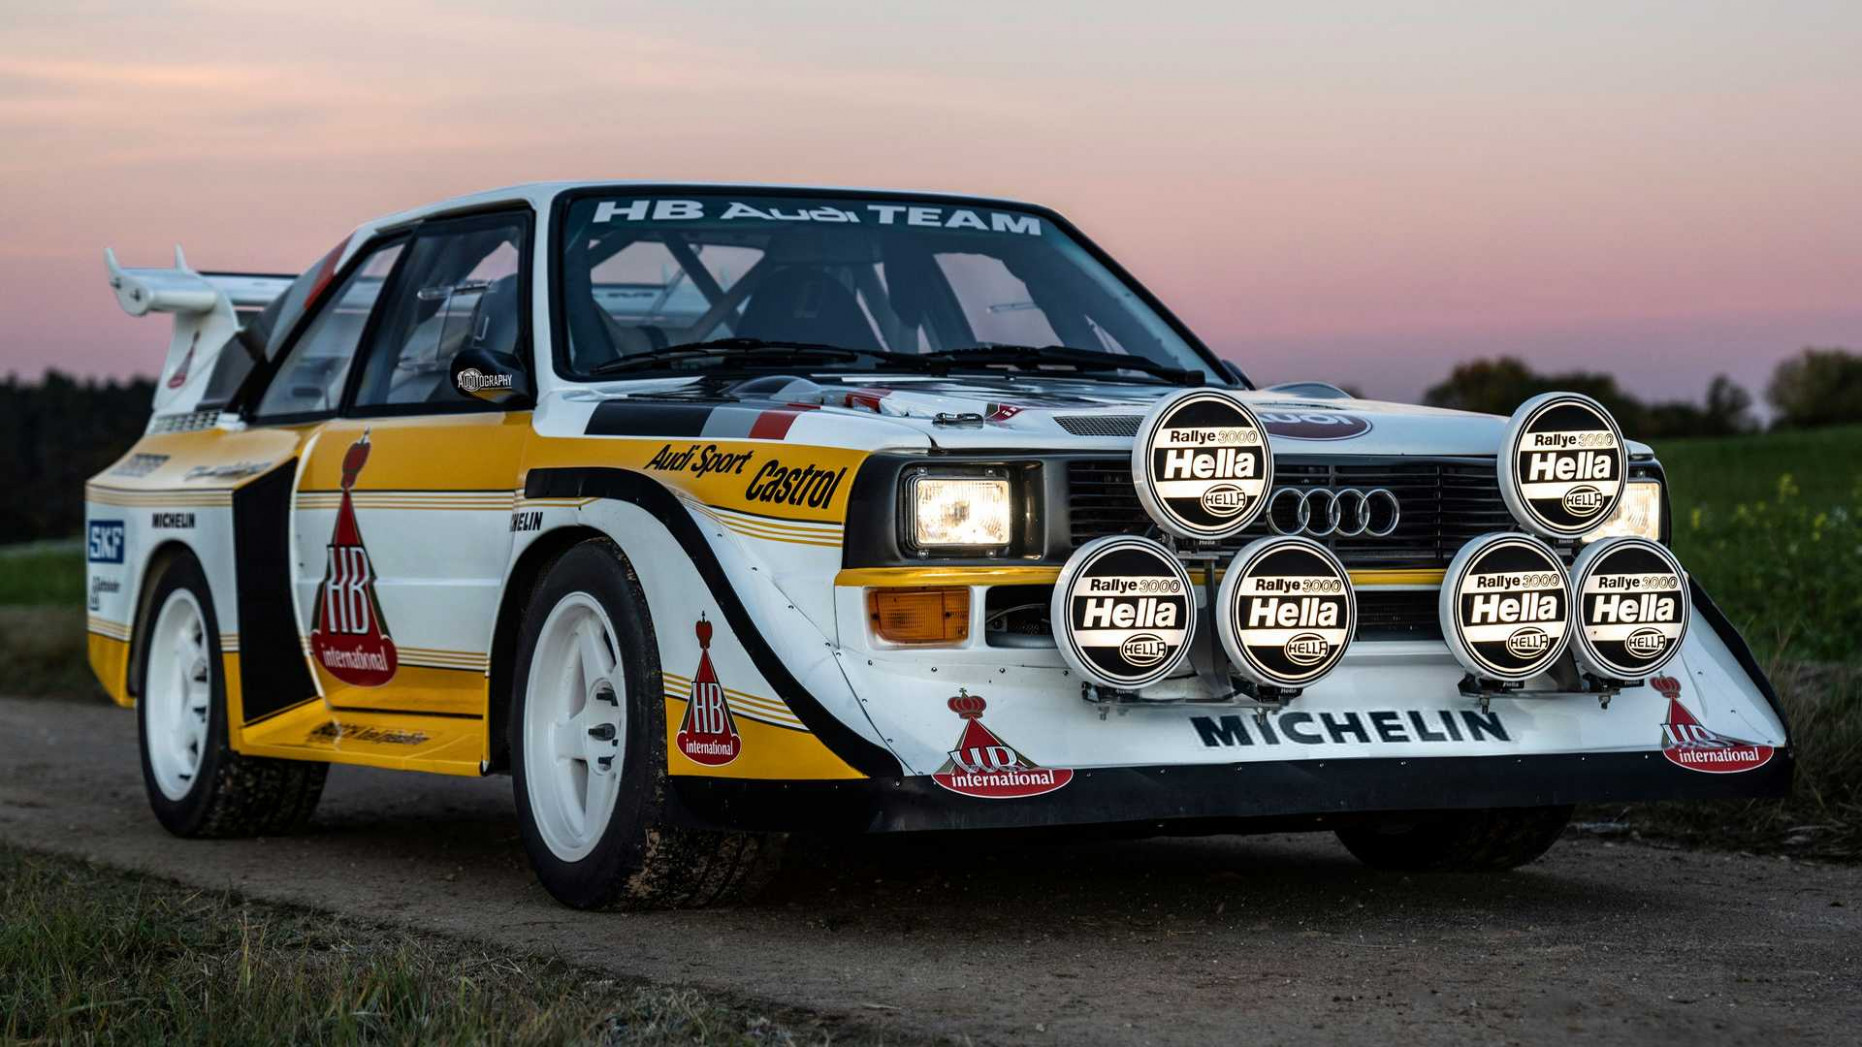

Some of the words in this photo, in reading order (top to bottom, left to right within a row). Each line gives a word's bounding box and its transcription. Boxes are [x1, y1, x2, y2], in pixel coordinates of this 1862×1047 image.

[593, 200, 704, 223] HB
[720, 202, 860, 223] Audi
[867, 205, 1042, 236] TEAM
[1170, 430, 1216, 444] Rallye
[1218, 430, 1257, 443] 3000
[1535, 434, 1576, 447] Rallye
[1579, 433, 1613, 446] 3000
[644, 444, 700, 471] Audi
[690, 444, 754, 478] Sport
[1164, 449, 1255, 479] Hella
[1529, 451, 1611, 480] Hella
[745, 459, 848, 510] Castrol
[1206, 492, 1245, 505] HELLA
[1566, 493, 1602, 506] HELLA
[151, 513, 195, 529] MICHELIN
[89, 526, 123, 560] SKF
[1090, 579, 1137, 593] Rallye
[1139, 580, 1180, 593] 3000
[1256, 579, 1300, 593] Rallye
[1302, 580, 1341, 592] 3000
[1477, 576, 1520, 589] Rallye
[1522, 574, 1560, 588] 3000
[1599, 577, 1640, 590] Rallye
[1642, 576, 1678, 589] 3000
[326, 546, 371, 635] HB
[1083, 598, 1177, 628] Hella
[1249, 598, 1338, 626] Hella
[1471, 592, 1557, 623] Hella
[1592, 594, 1675, 623] Hella
[1125, 642, 1166, 656] HELLA
[1289, 641, 1328, 655] HELLA
[1511, 635, 1548, 648] HELLA
[1630, 635, 1665, 648] HELLA
[321, 643, 388, 672] international
[692, 682, 725, 734] HB
[1190, 710, 1511, 747] MICHELIN
[686, 738, 734, 756] international
[1679, 747, 1760, 763] international
[951, 770, 1055, 787] international
